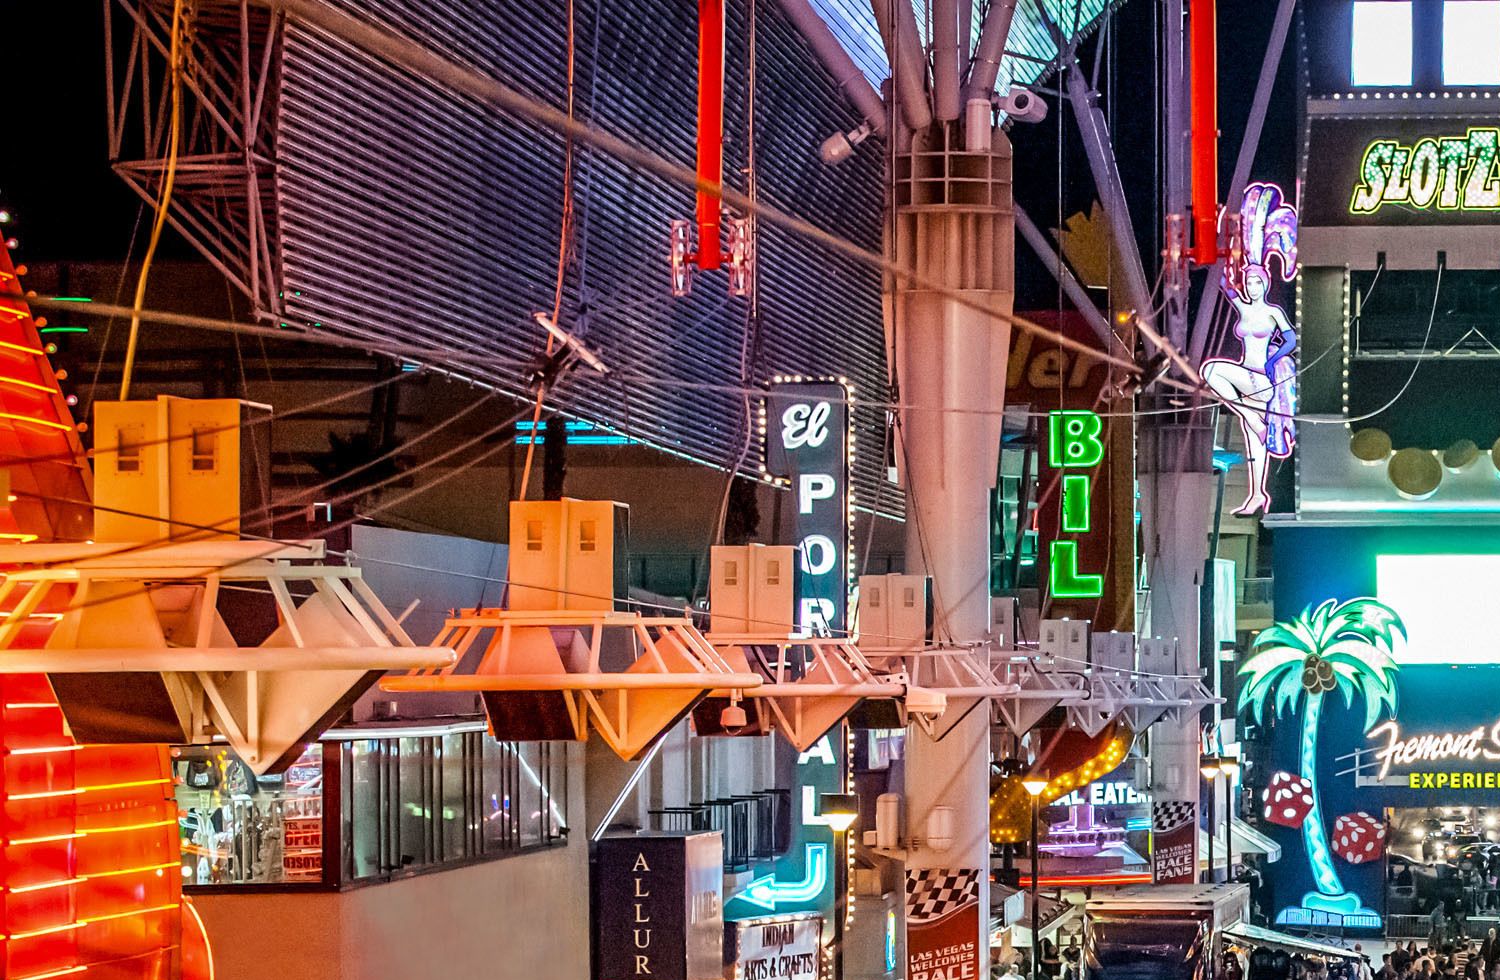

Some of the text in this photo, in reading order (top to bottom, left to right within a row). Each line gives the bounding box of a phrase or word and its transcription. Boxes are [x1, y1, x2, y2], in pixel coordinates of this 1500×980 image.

[781, 401, 832, 450] El
[798, 474, 839, 826] PORAL
[1366, 720, 1485, 783] Fremont
[1091, 782, 1152, 805] EATE
[1156, 854, 1192, 871] RACE
[1156, 864, 1192, 881] FANS
[762, 923, 795, 955] INDIAN
[911, 941, 975, 964] LAS VEGAS
[911, 951, 975, 973] WELCOMES
[770, 957, 777, 979] &
